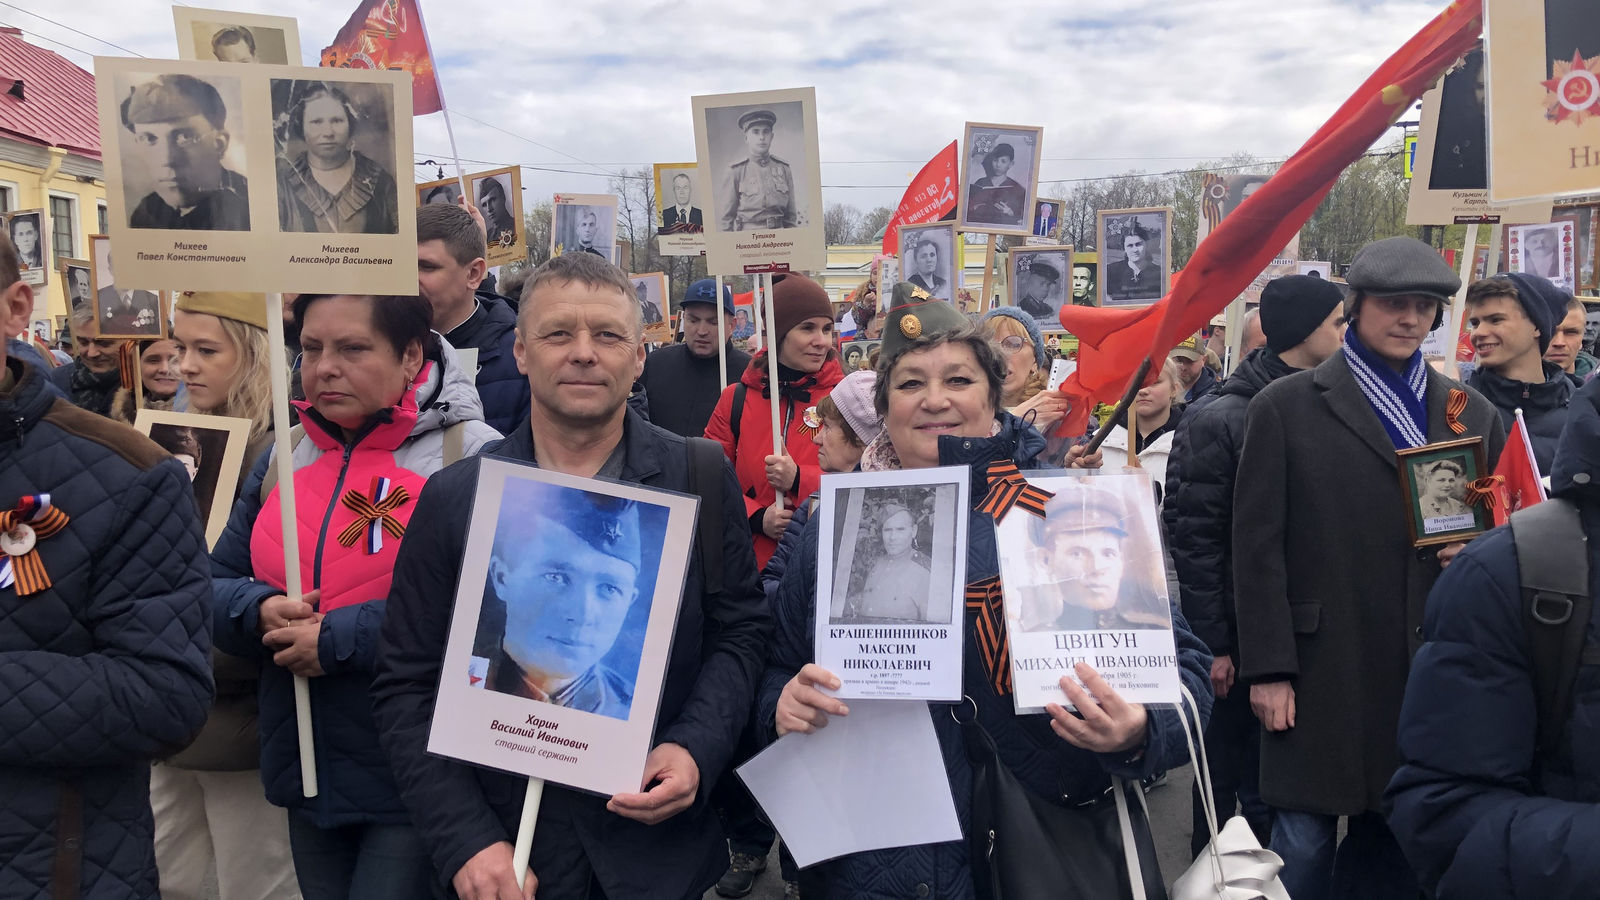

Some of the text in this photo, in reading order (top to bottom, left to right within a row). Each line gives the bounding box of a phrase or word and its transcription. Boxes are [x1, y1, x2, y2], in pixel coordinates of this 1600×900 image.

[1452, 191, 1481, 199] Кузьмин
[174, 241, 208, 251] Михеев
[322, 244, 360, 253] Михеева
[736, 241, 793, 250] Николай Андреевич
[137, 252, 246, 263] Павел Константинович
[289, 255, 393, 266] Александра Васильевна
[830, 628, 948, 640] КРАШЕНИННИКОВ
[1054, 632, 1138, 654] ЦВИГУН
[858, 644, 916, 655] МАКСИМ
[843, 659, 932, 671] НИКОЛАЕВИЧ
[1095, 655, 1177, 668] ИВАНОВИЧ
[525, 713, 559, 731] Харин
[491, 719, 589, 751] Василий Иванович
[494, 739, 578, 764] старший сержант
